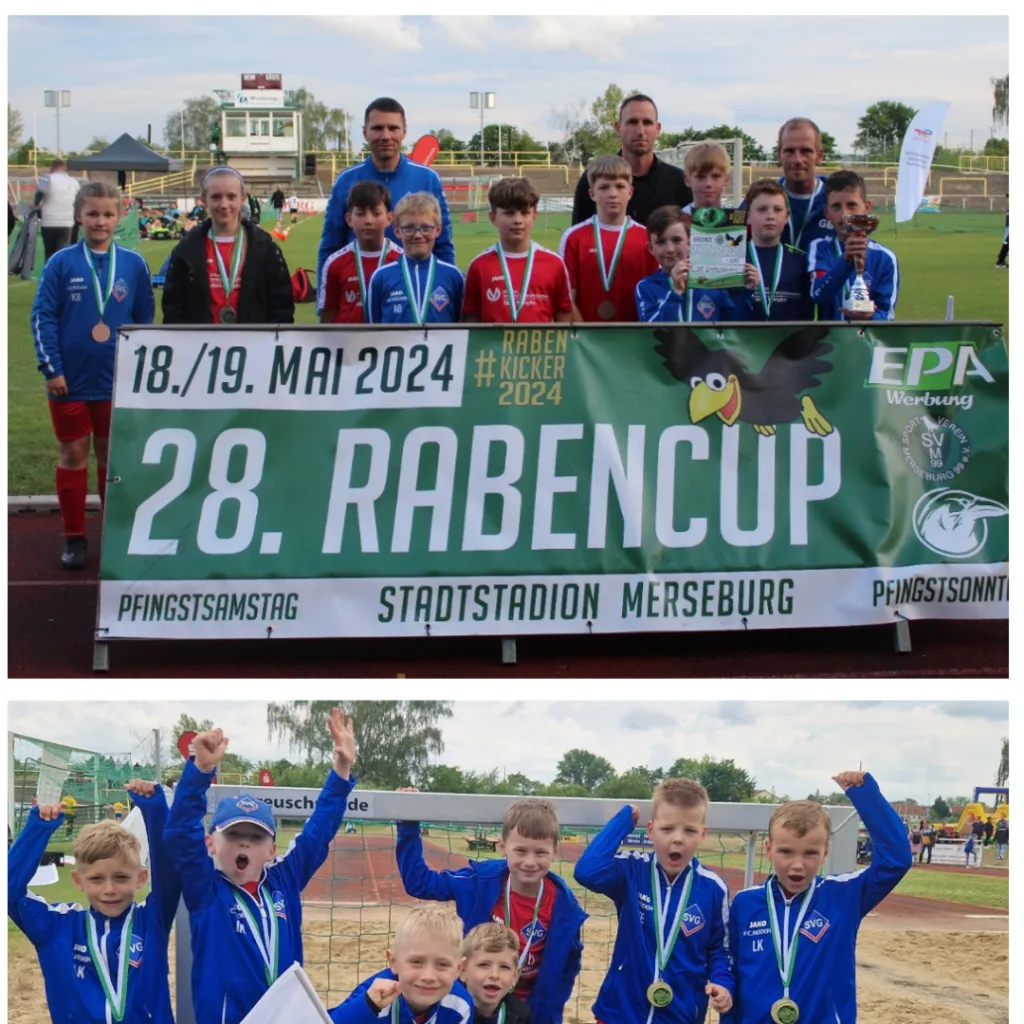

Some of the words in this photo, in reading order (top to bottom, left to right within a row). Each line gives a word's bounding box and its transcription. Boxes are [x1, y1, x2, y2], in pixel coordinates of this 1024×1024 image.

[501, 329, 568, 354] RABEN
[133, 342, 254, 399] 18./19.
[268, 346, 343, 396] MAI
[355, 344, 454, 395] 2024
[498, 354, 565, 380] KICKER
[868, 346, 996, 386] EPA
[498, 380, 563, 406] 2024
[886, 389, 974, 410] Werbung
[921, 432, 945, 447] SV
[938, 415, 968, 444] VEREIN
[902, 447, 955, 482] MERSEBURG
[929, 447, 943, 460] M
[127, 426, 284, 557] 28.
[321, 423, 843, 555] RABENCUP
[117, 593, 299, 622] PFINGSTSAMSTAG
[378, 580, 600, 623] STADTSTADION
[621, 577, 795, 619] MERSEBURG
[683, 912, 701, 925] SVG
[749, 920, 767, 928] JAKO
[804, 918, 824, 930] SVG
[526, 928, 544, 937] SVG
[128, 941, 144, 953] VG
[752, 939, 764, 952] LK
